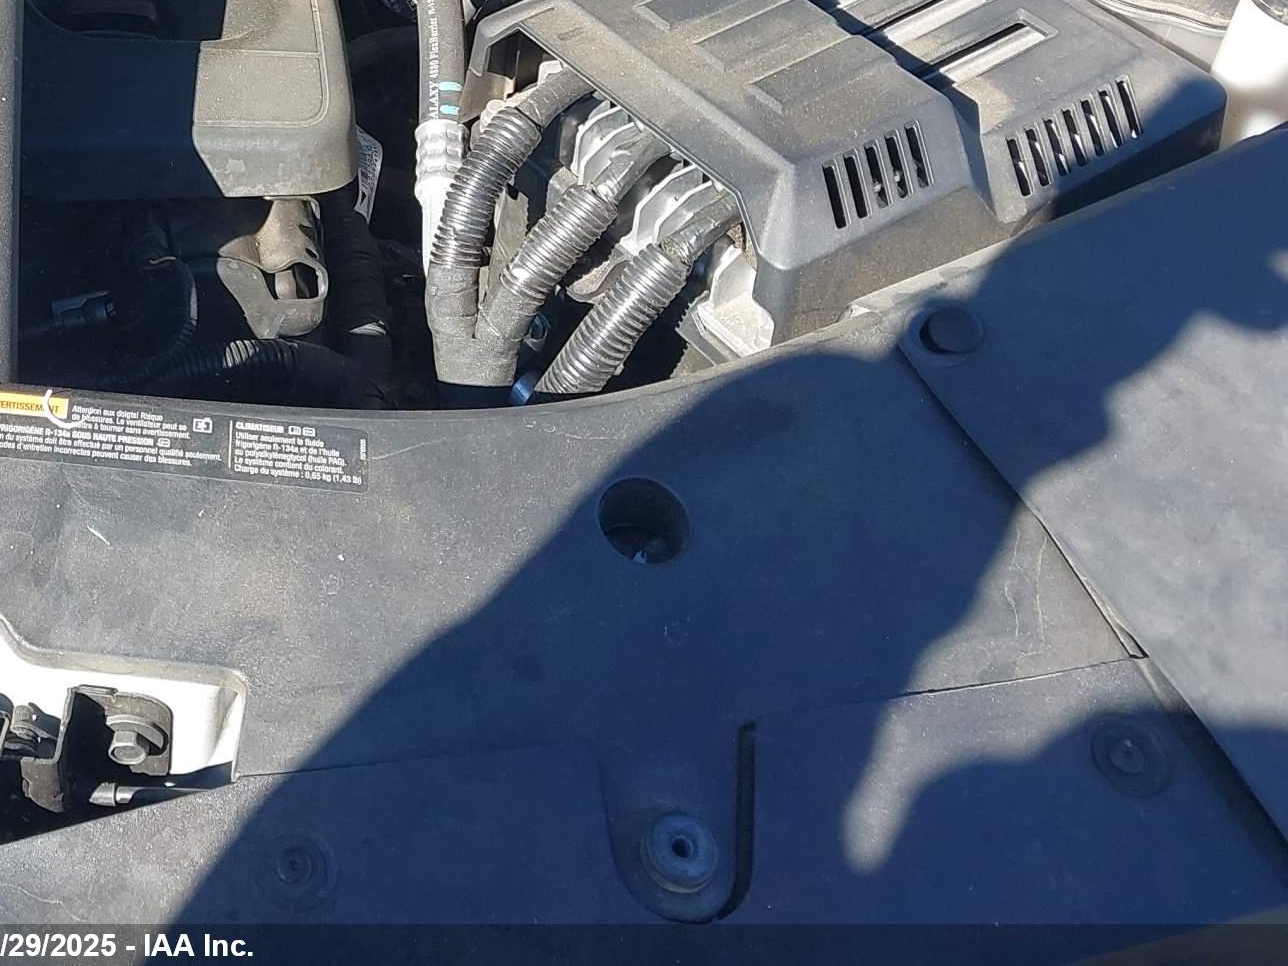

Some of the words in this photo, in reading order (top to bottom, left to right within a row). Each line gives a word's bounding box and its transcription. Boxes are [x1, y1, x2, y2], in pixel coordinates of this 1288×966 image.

[428, 81, 439, 120] ALAXY
[72, 406, 102, 415] Attention
[140, 412, 163, 422] Risque
[100, 424, 124, 432] tourner
[143, 428, 191, 440] avertissement.
[126, 420, 161, 428] ventilateur
[162, 422, 176, 432] peut
[236, 422, 284, 434] CLIMATISEUR
[44, 436, 57, 444] doit
[125, 446, 158, 455] personnel
[72, 430, 92, 439] SOUS
[93, 432, 117, 442] HAUTE
[118, 436, 154, 446] PRESSION
[236, 432, 258, 440] Utiliser
[260, 434, 296, 444] seulement
[305, 438, 324, 448] fluide
[16, 442, 52, 452] d'entretien
[54, 446, 90, 456] incorrectes
[92, 450, 119, 459] peuvent
[120, 453, 142, 461] causer
[144, 454, 156, 462] des
[158, 456, 192, 466] blessures.
[308, 447, 317, 455] de
[234, 456, 242, 464] Le
[275, 461, 302, 470] contient
[314, 464, 344, 474] colorant.
[308, 454, 326, 465] (huile
[234, 465, 258, 475] Charge
[260, 467, 269, 475] du
[322, 474, 331, 482] kg
[352, 476, 362, 485] lb)
